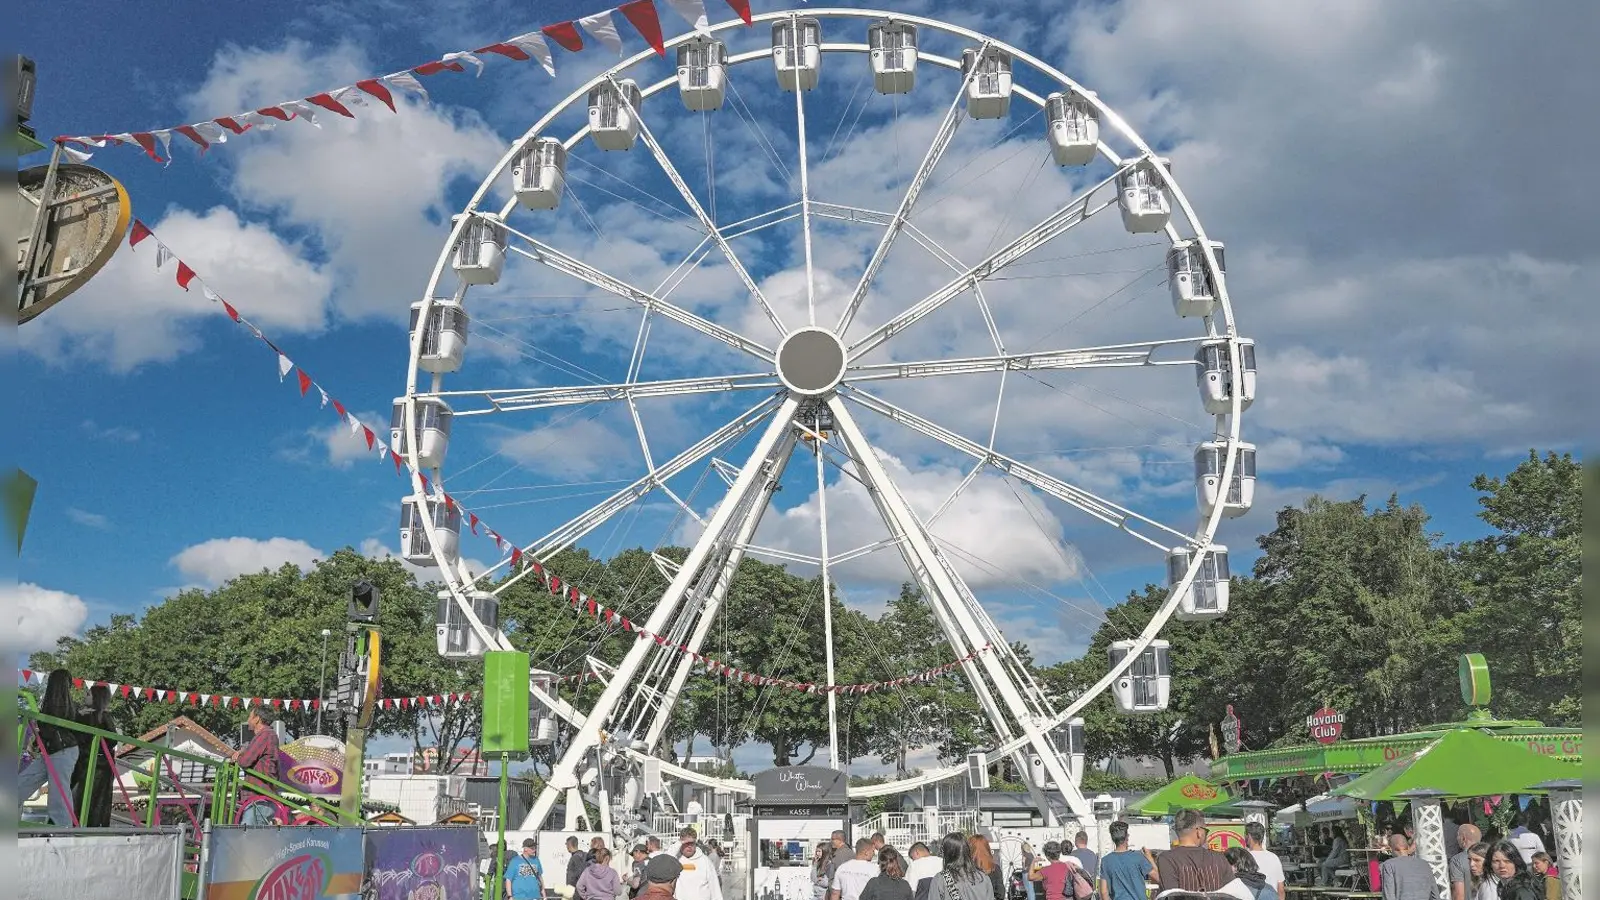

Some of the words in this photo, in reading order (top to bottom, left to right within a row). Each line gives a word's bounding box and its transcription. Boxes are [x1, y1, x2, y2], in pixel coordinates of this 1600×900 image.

[1306, 712, 1345, 727] Havana
[1314, 725, 1336, 738] Club
[779, 770, 805, 782] White
[795, 778, 822, 791] Wheel
[789, 808, 811, 816] KASSE
